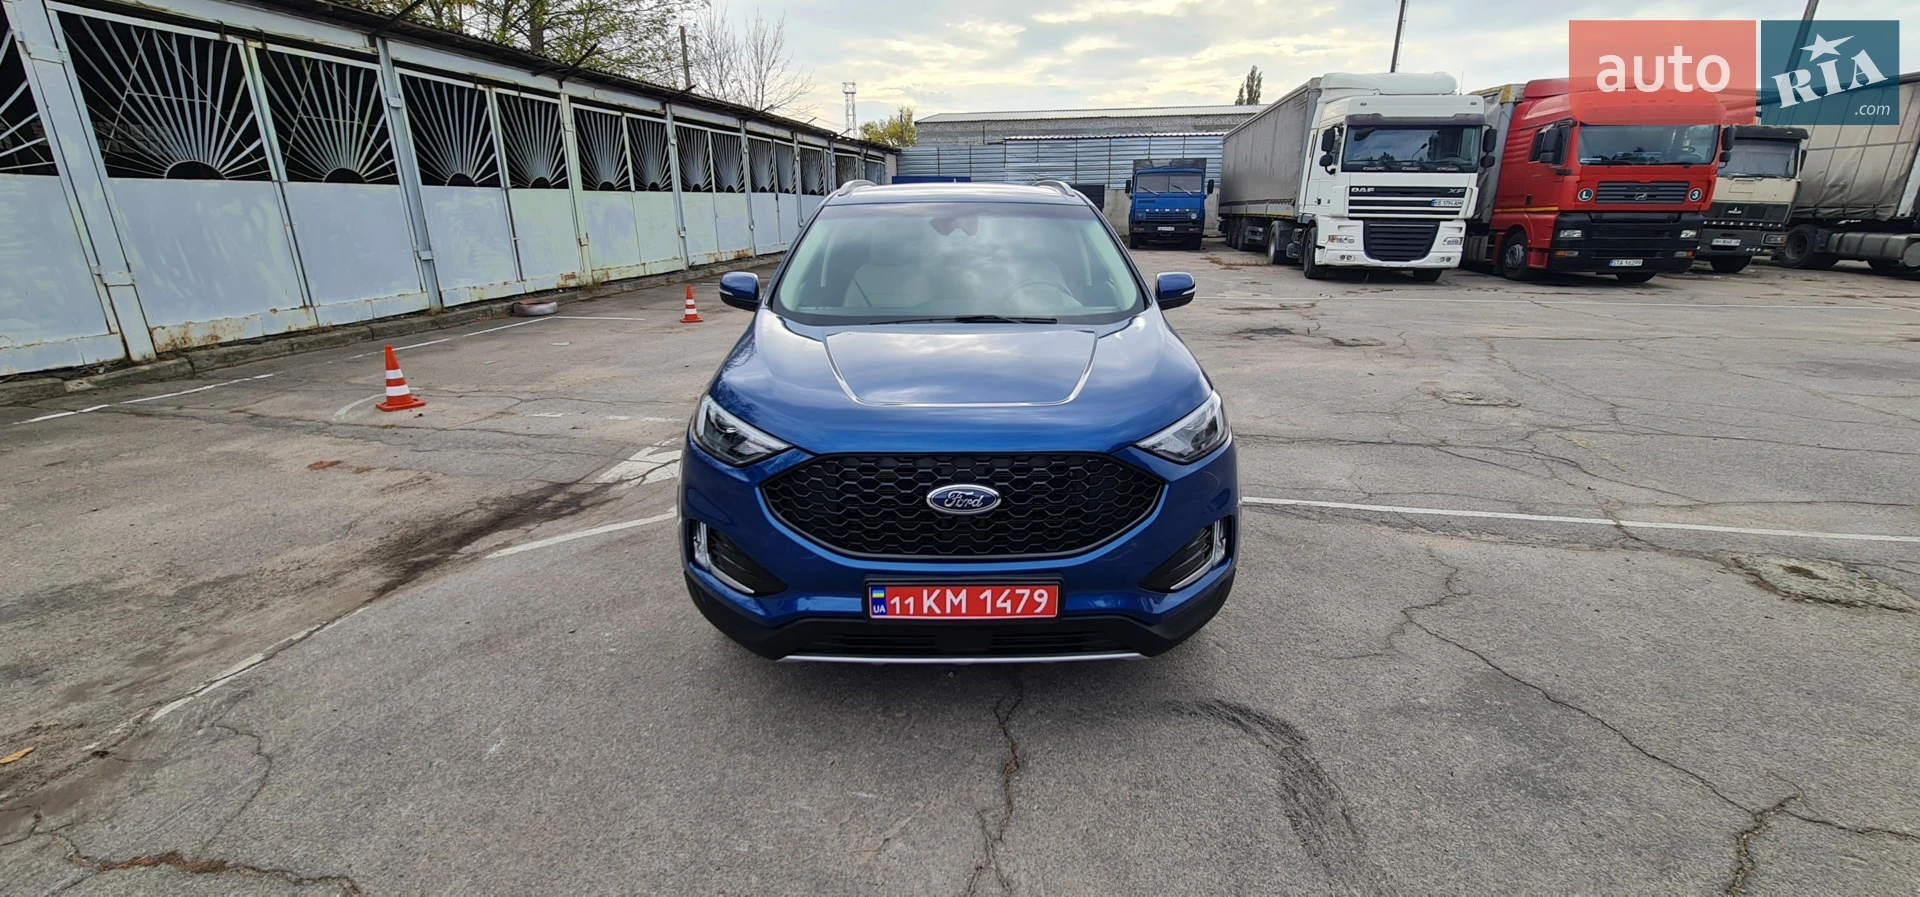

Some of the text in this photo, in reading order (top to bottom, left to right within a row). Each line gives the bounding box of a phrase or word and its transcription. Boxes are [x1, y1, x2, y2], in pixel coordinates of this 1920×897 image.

[1582, 191, 1589, 199] L
[1692, 191, 1699, 199] 3
[944, 490, 984, 508] Ford
[979, 589, 1049, 614] 1479
[873, 605, 886, 614] UA
